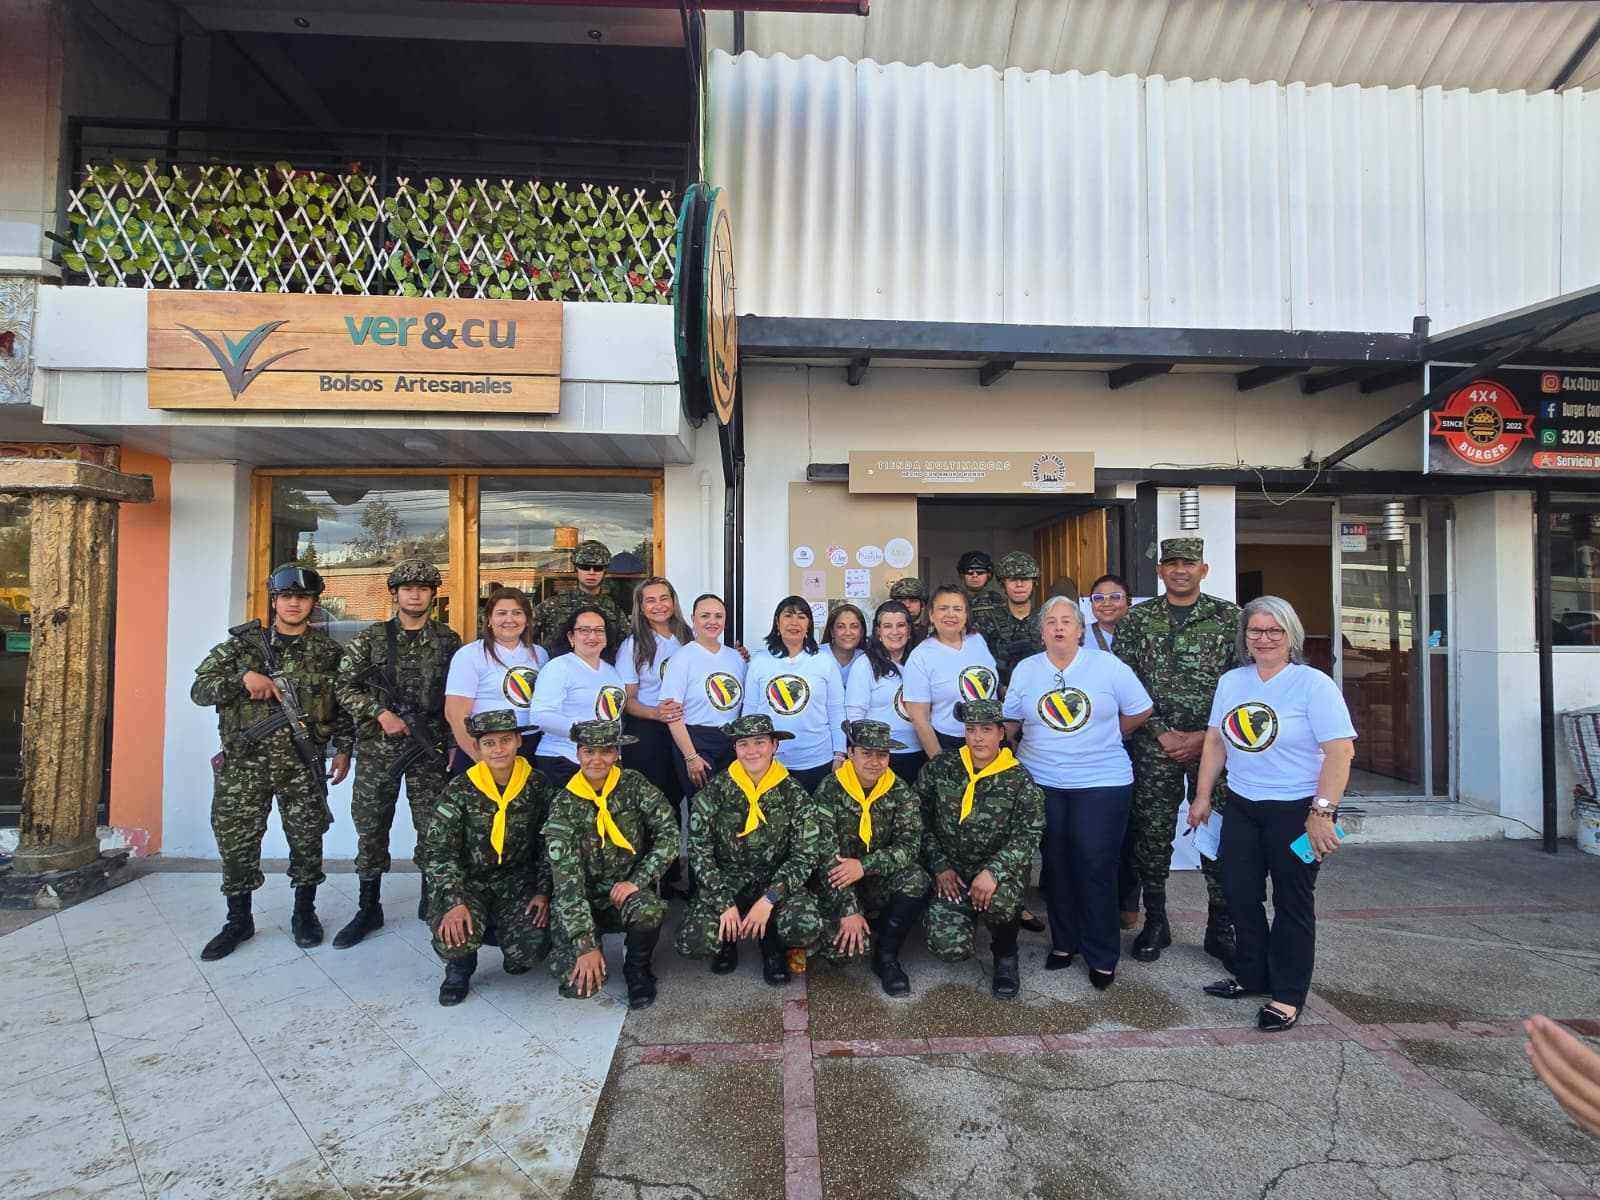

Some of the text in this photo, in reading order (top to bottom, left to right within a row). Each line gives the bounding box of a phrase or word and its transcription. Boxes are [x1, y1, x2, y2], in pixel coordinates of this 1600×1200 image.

[344, 311, 517, 350] ver&cu
[319, 375, 513, 394] Bolsos Artesanales
[1562, 376, 1600, 392] 4x4bu
[1469, 390, 1498, 402] 4X4
[1562, 401, 1586, 418] Burger
[1442, 420, 1463, 428] SINCE
[1505, 422, 1522, 430] 2022
[1561, 429, 1584, 445] 320
[1458, 441, 1509, 460] BURGER
[1556, 455, 1593, 467] Servicio
